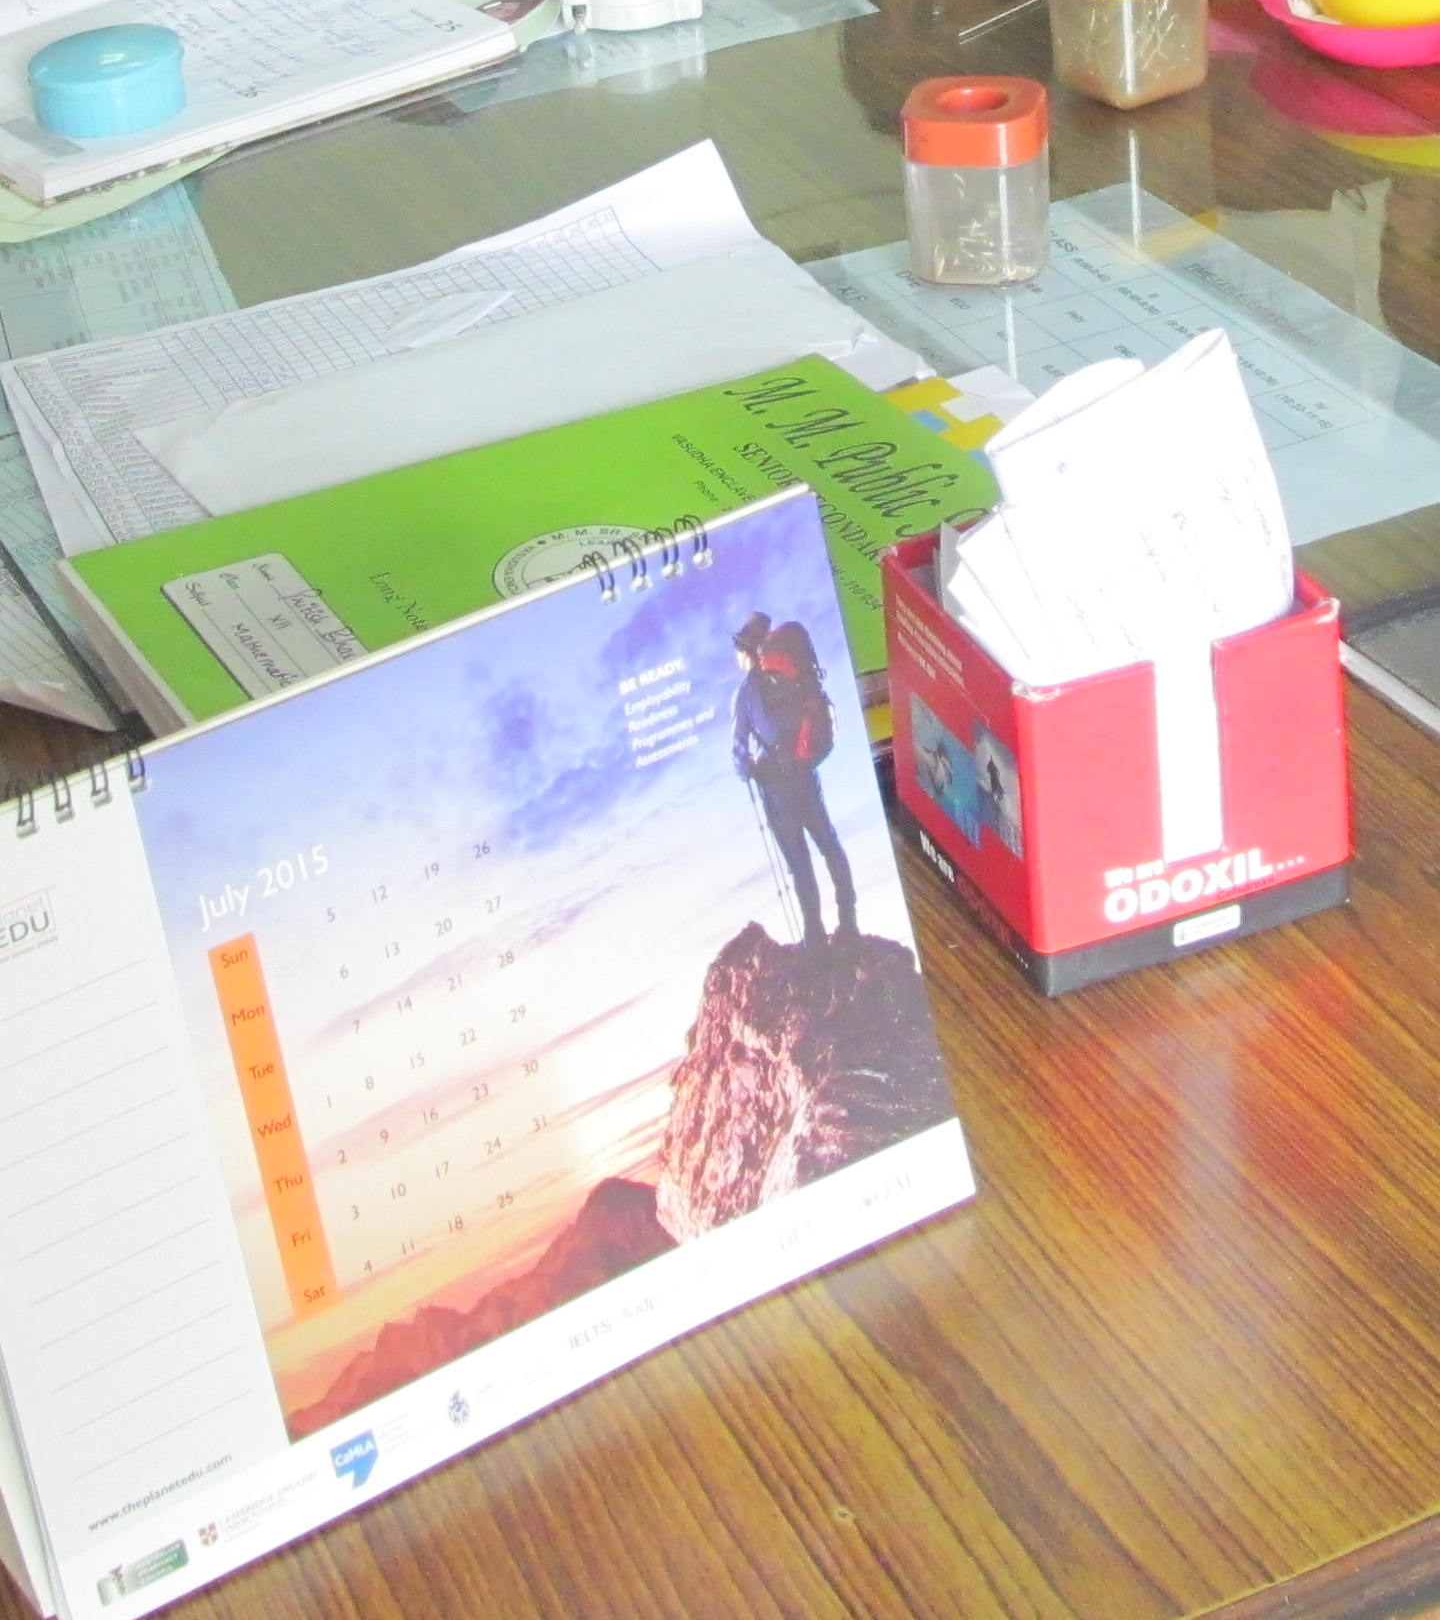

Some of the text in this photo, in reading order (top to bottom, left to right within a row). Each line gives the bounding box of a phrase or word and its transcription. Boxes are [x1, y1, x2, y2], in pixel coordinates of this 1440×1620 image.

[1048, 231, 1079, 255] ASS
[721, 375, 822, 416] M.
[764, 406, 868, 450] M.
[812, 440, 960, 519] Public
[618, 657, 686, 696] BE READY.
[623, 680, 692, 717] Employability
[627, 704, 679, 734] Readiness
[631, 704, 715, 751] Programmes and
[635, 733, 699, 769] Assessments
[196, 843, 332, 933] July 2015
[1104, 859, 1166, 889] We are
[220, 840, 492, 969] Sun 5 12 19 26
[231, 894, 503, 1028] Mon 6 13 20 27
[248, 949, 516, 1080] Tue 7 14 21 28
[257, 1004, 527, 1139] Wed 1 8 15 22 29
[272, 1058, 540, 1195] Thu 2 9 16 23 30
[291, 1113, 549, 1248] Fri 3 10 17 24 31
[303, 1189, 515, 1305] Sat 4 11 18 25
[568, 1317, 615, 1353] IELTS
[334, 1437, 377, 1469] CaMLA
[87, 1452, 233, 1533] www.theplanetedu.com
